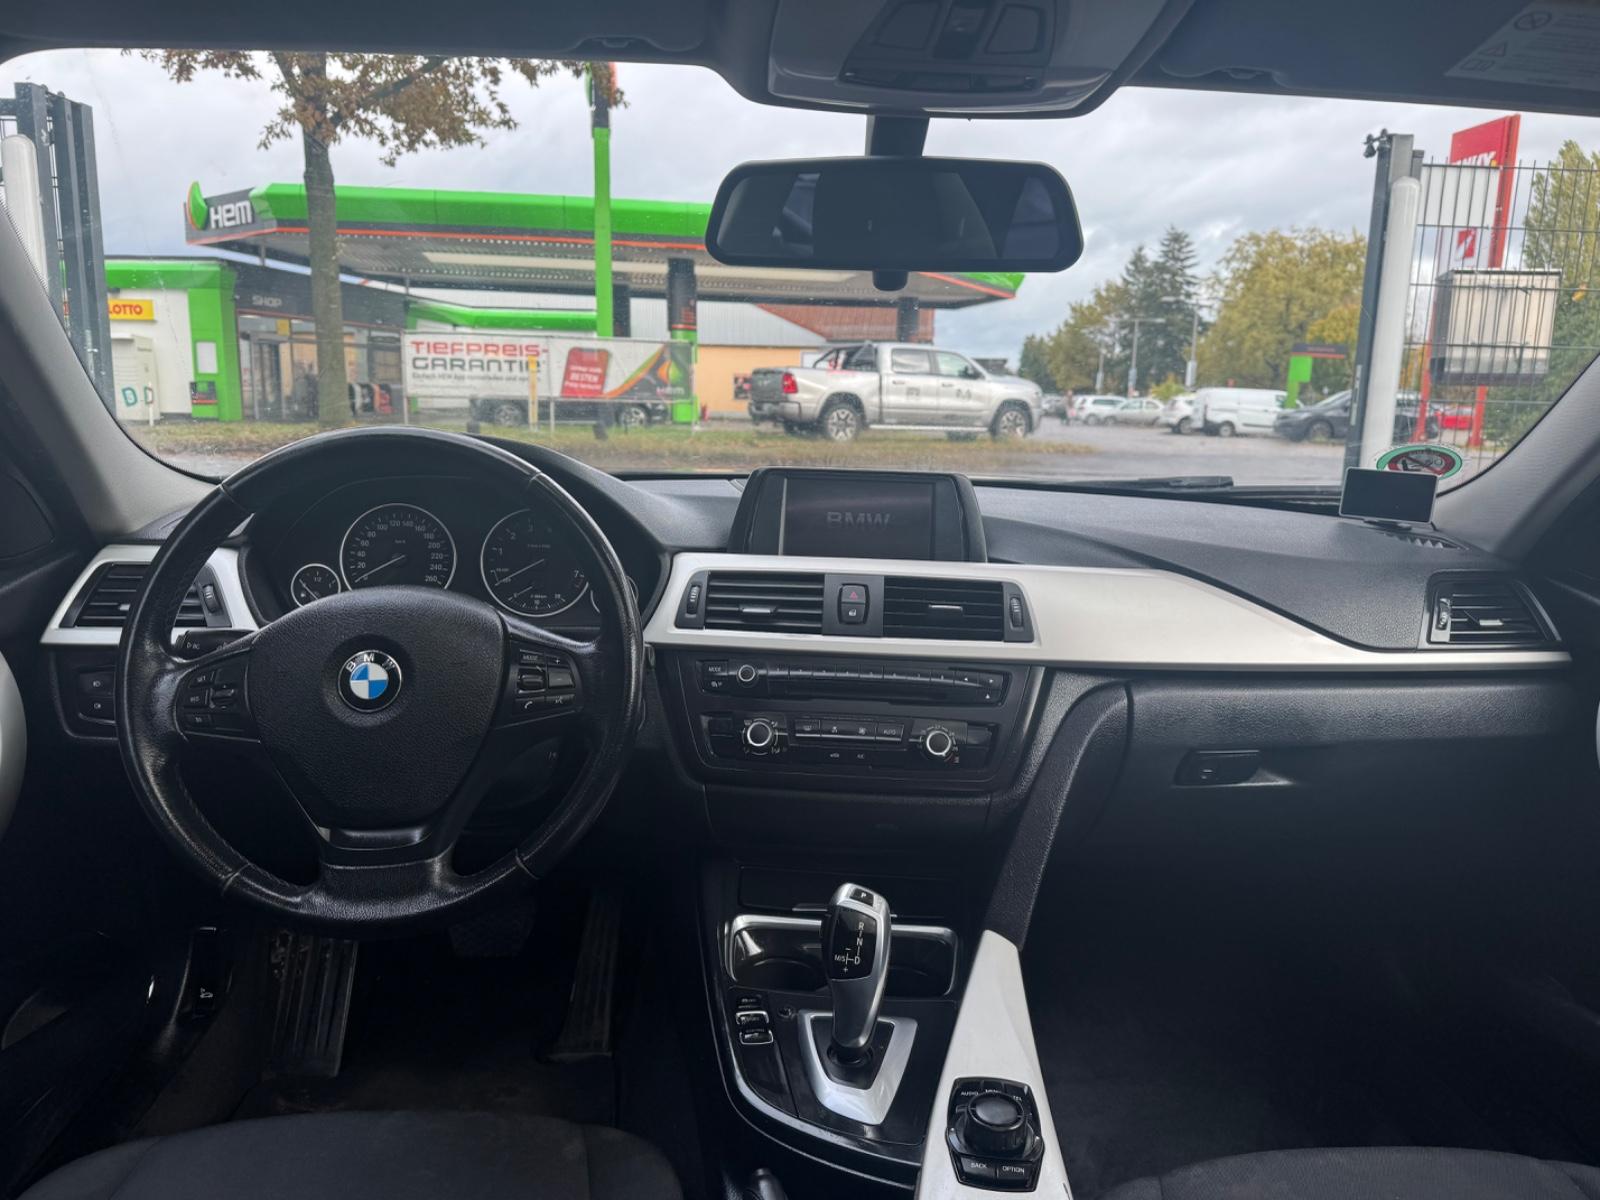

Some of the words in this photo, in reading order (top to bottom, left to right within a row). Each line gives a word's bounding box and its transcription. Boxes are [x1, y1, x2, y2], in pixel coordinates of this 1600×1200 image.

[252, 294, 282, 307] SHOP
[826, 511, 892, 529] BMW
[345, 652, 396, 673] BMW
[858, 922, 864, 930] R
[857, 938, 863, 946] N
[854, 956, 861, 965] D
[1002, 1165, 1025, 1174] OPTION
